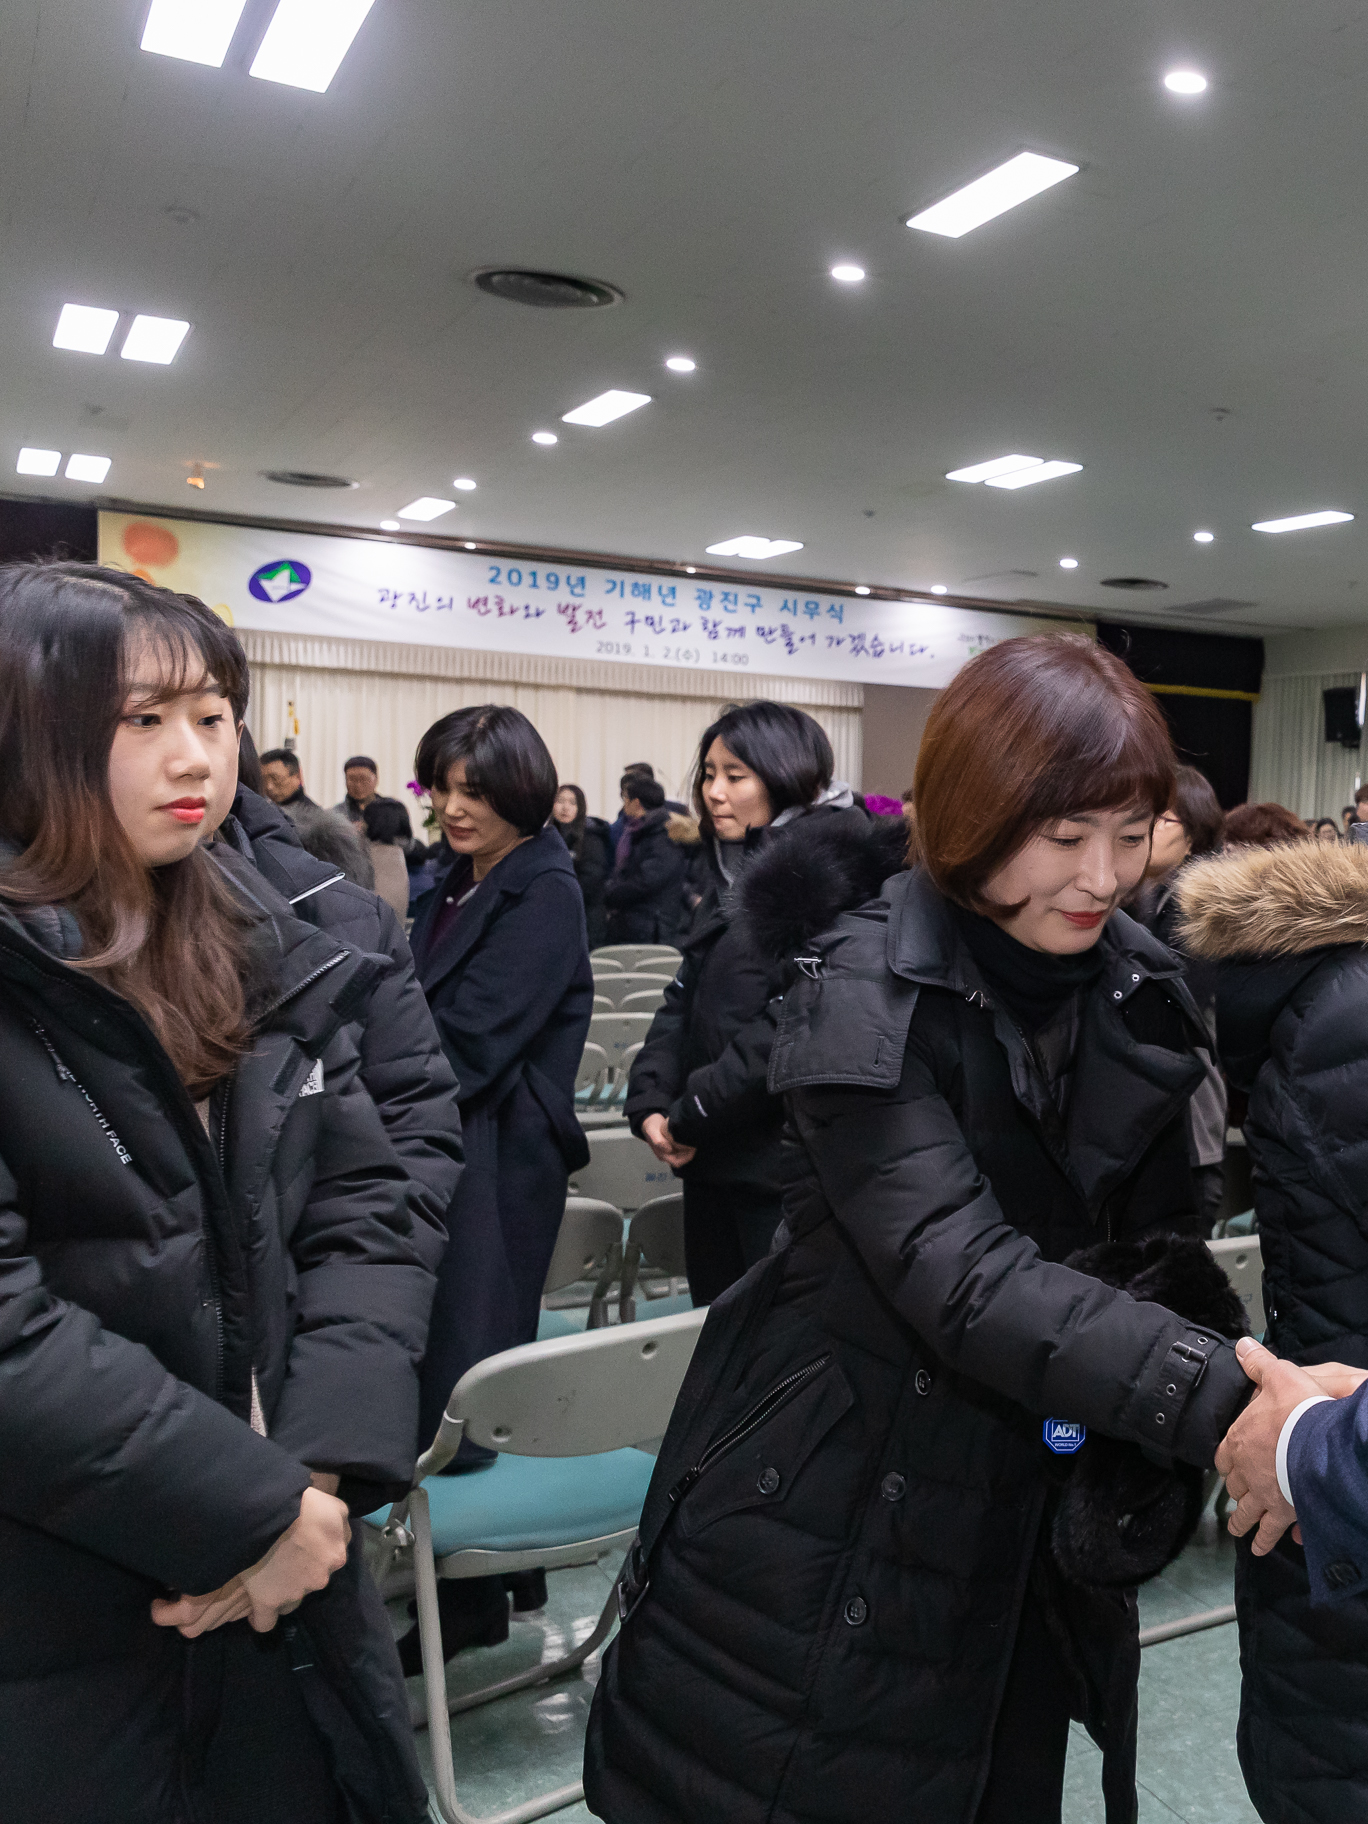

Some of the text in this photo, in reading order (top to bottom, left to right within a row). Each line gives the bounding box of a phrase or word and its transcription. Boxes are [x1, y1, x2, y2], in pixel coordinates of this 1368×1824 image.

[488, 565, 586, 598] 2019년
[604, 578, 677, 607] 기해년
[694, 587, 763, 615] 광진구
[378, 588, 454, 612] 광진의
[466, 594, 547, 619] 변화와
[556, 601, 608, 634] 발전
[624, 610, 692, 635] 구민과
[700, 616, 747, 640] 함께
[756, 623, 816, 656] 만들어
[825, 633, 936, 659] 가겠습니다.
[105, 1130, 133, 1165] FACE
[1053, 1423, 1080, 1438] ADT
